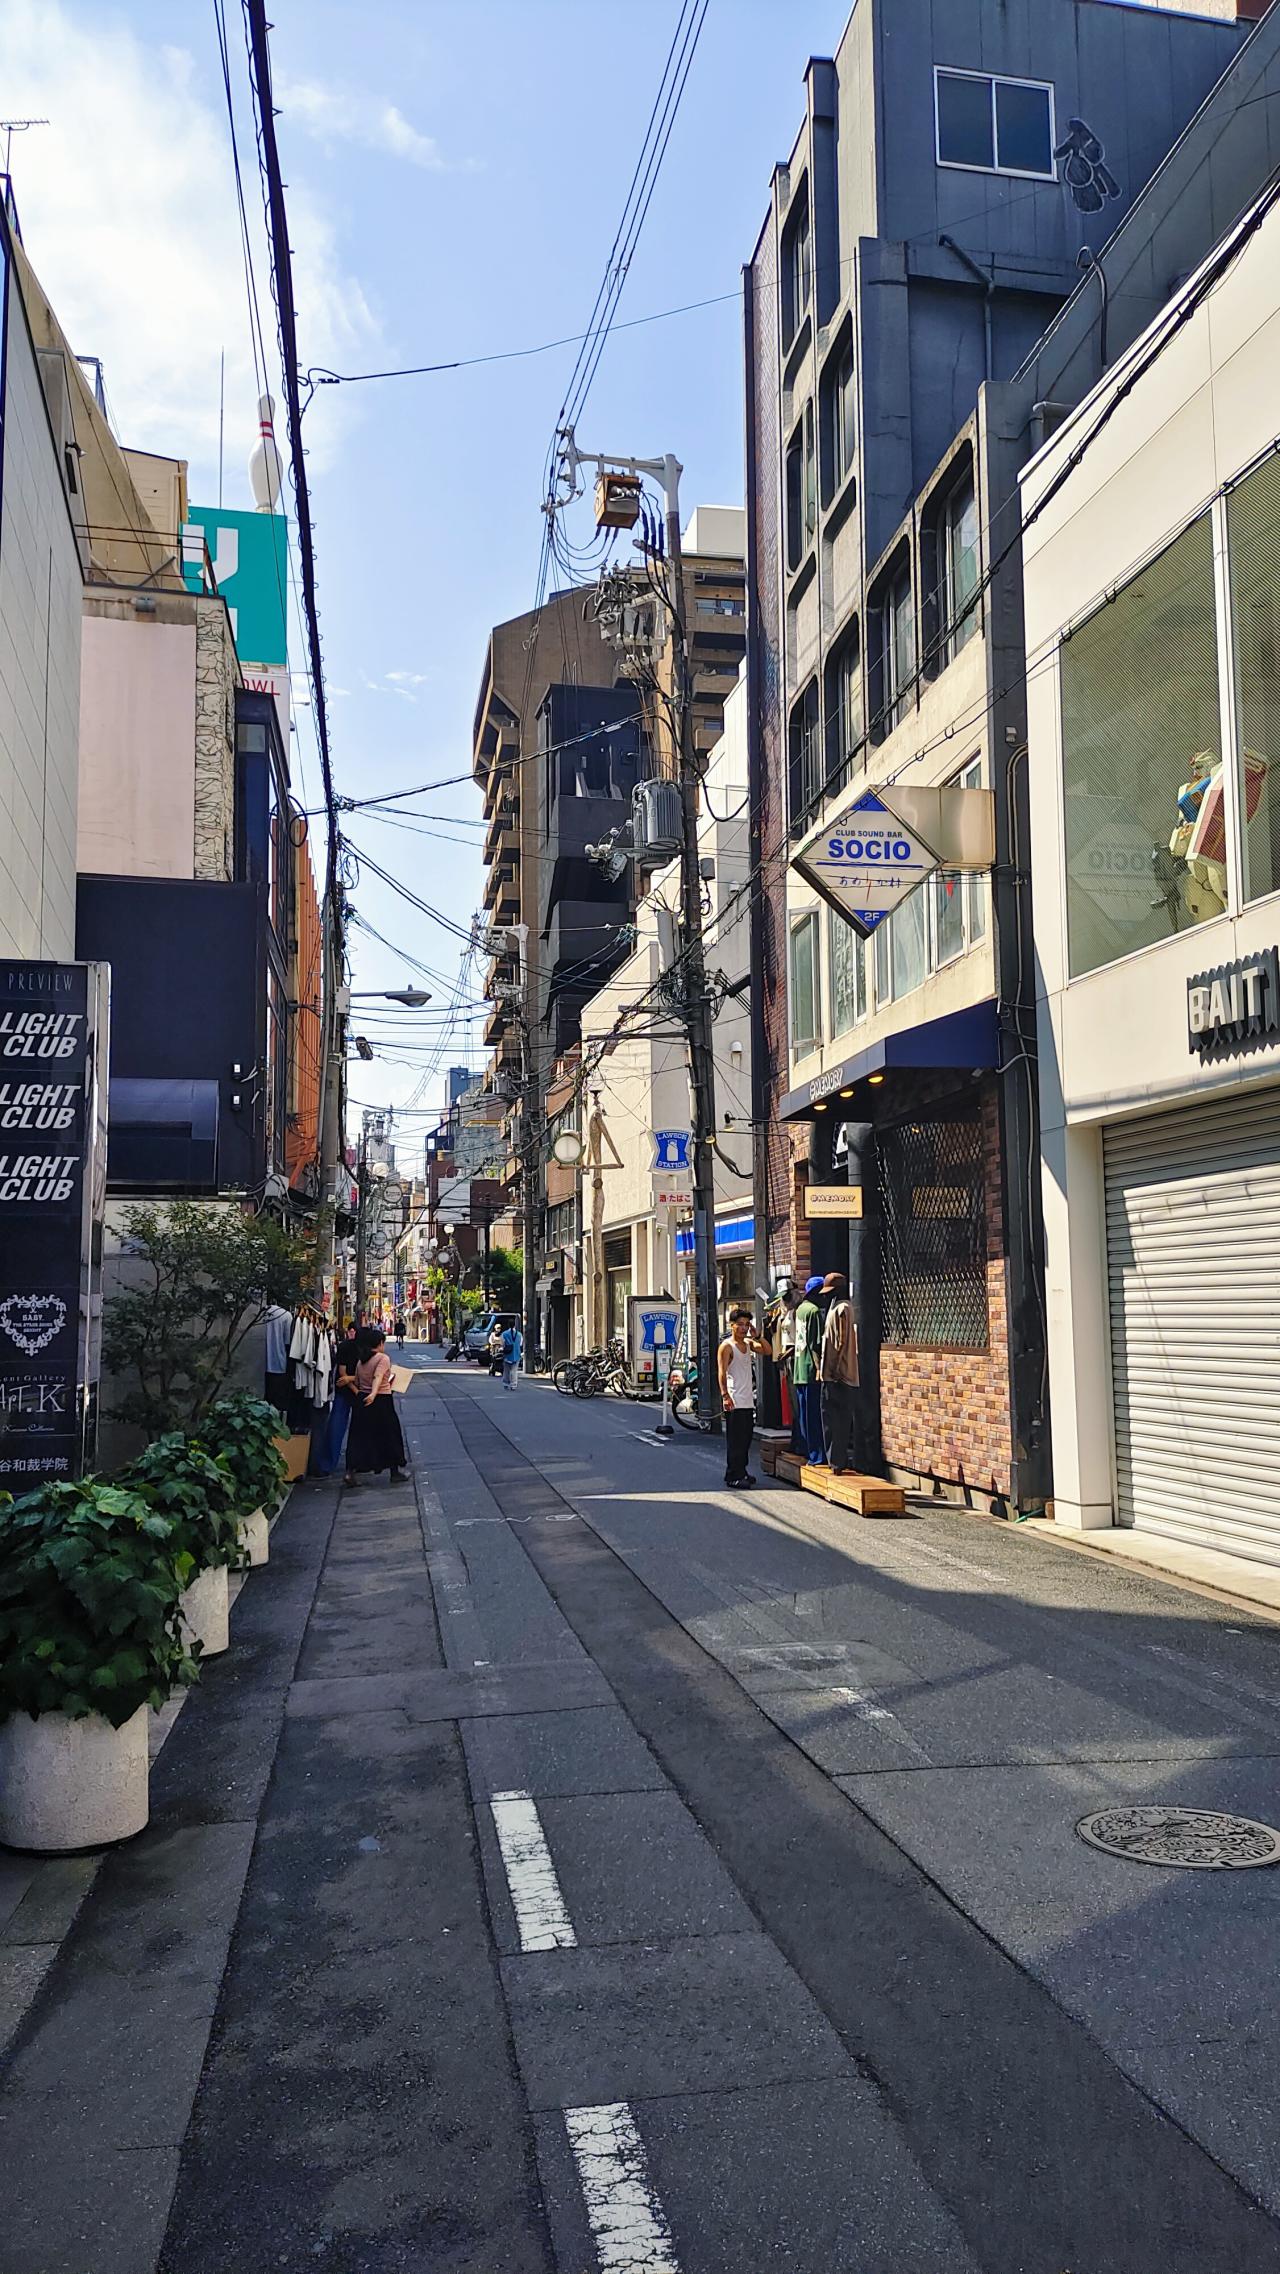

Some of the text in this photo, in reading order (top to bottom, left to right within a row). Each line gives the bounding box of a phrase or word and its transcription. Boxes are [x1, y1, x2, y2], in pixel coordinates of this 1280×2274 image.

[828, 839, 911, 860] SOCIO
[864, 912, 880, 922] 2F
[8, 973, 73, 991] PREVIEW
[1188, 966, 1264, 1034] BAIT
[0, 1012, 84, 1035] LIGHT
[3, 1034, 78, 1058] CLUB
[0, 1083, 82, 1106] LIGHT
[1, 1106, 76, 1129] CLUB
[657, 1132, 688, 1140] LAWSON
[0, 1155, 80, 1178] LIGHT
[0, 1178, 74, 1201] CLUB
[644, 1313, 676, 1322] LAWSON
